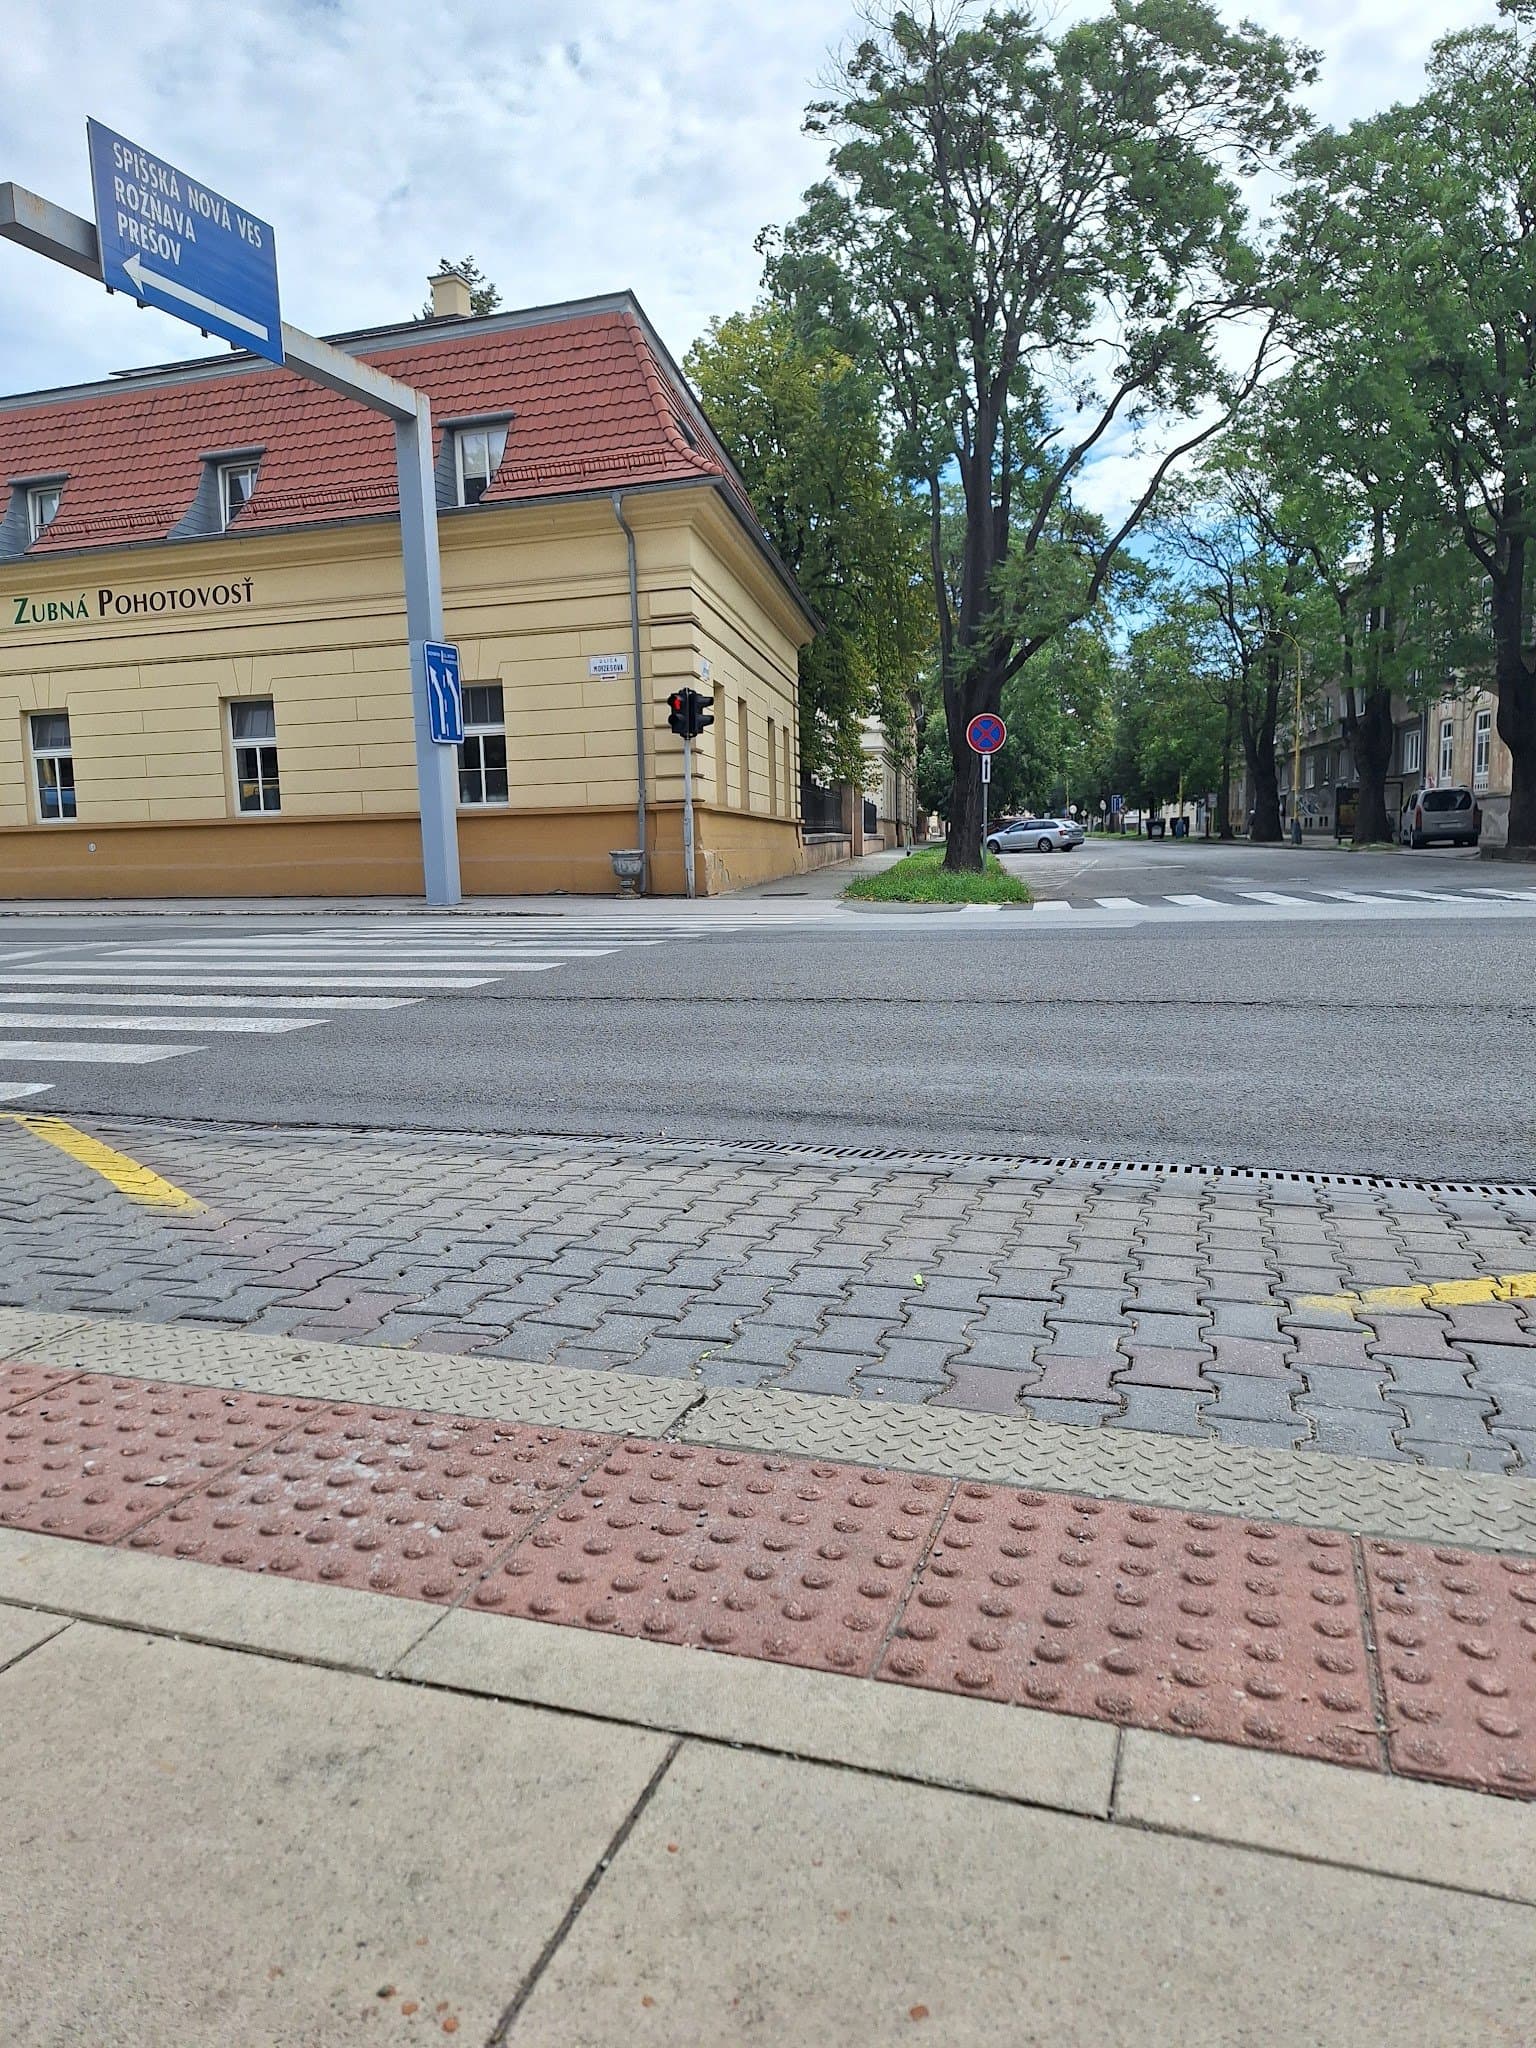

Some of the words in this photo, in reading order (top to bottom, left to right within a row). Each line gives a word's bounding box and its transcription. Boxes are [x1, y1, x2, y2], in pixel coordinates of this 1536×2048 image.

[112, 142, 181, 202] SPIŠSKÁ
[188, 184, 231, 231] NOVÁ
[236, 213, 262, 248] VES
[114, 175, 196, 243] ROŽŇAVA
[117, 211, 181, 265] PREŠOV
